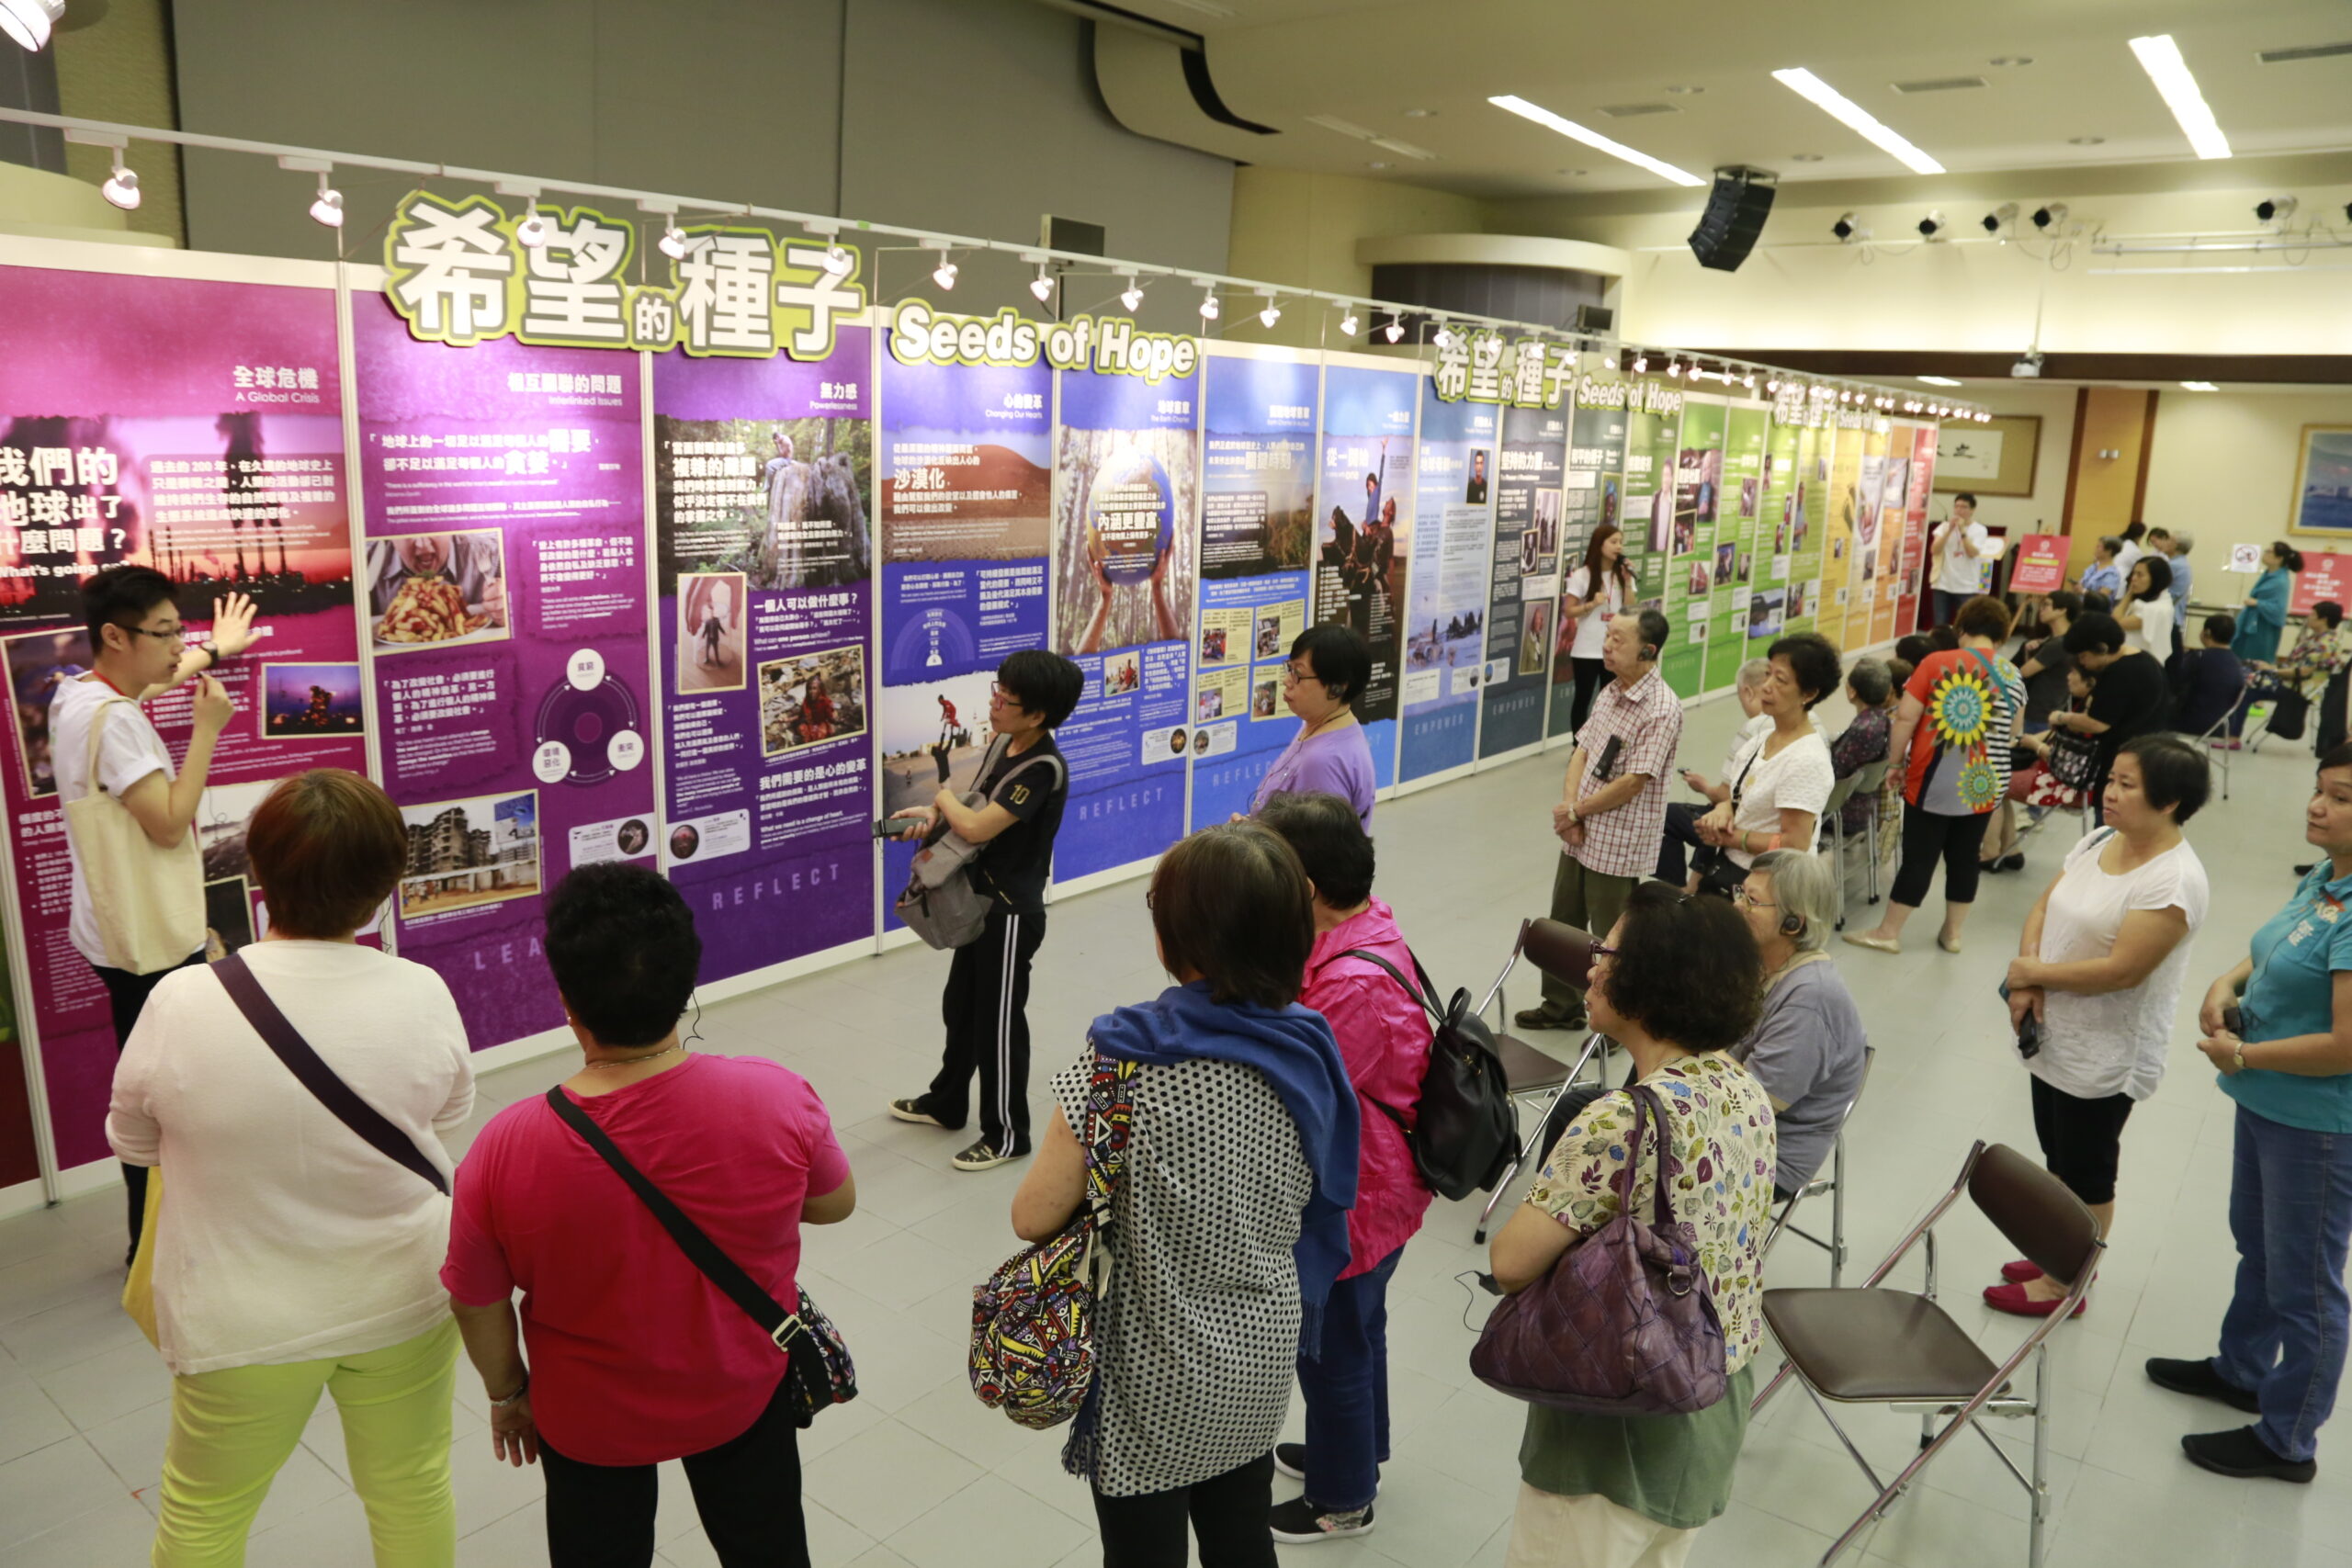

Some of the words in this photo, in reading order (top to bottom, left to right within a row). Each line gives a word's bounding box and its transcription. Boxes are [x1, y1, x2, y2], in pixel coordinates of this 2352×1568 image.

[397, 201, 860, 352] 希望的種子
[897, 305, 1035, 360] Seeds
[1051, 321, 1088, 363] of
[1099, 323, 1194, 379] Hope
[232, 366, 319, 389] 全球危機
[1438, 331, 1573, 404] 希望的種子
[235, 391, 246, 401] A
[248, 391, 288, 402] Global
[291, 391, 320, 403] Crisis
[820, 382, 857, 400] 無力感
[1579, 376, 1625, 407] Seeds
[1631, 382, 1644, 407] of
[1645, 380, 1681, 415] Hope
[0, 446, 118, 486] 我們的
[53, 562, 98, 577] going
[1009, 784, 1031, 806] 10
[1080, 788, 1163, 820] REFLECT
[713, 863, 839, 910] REFLECT
[474, 937, 541, 971] LEA
